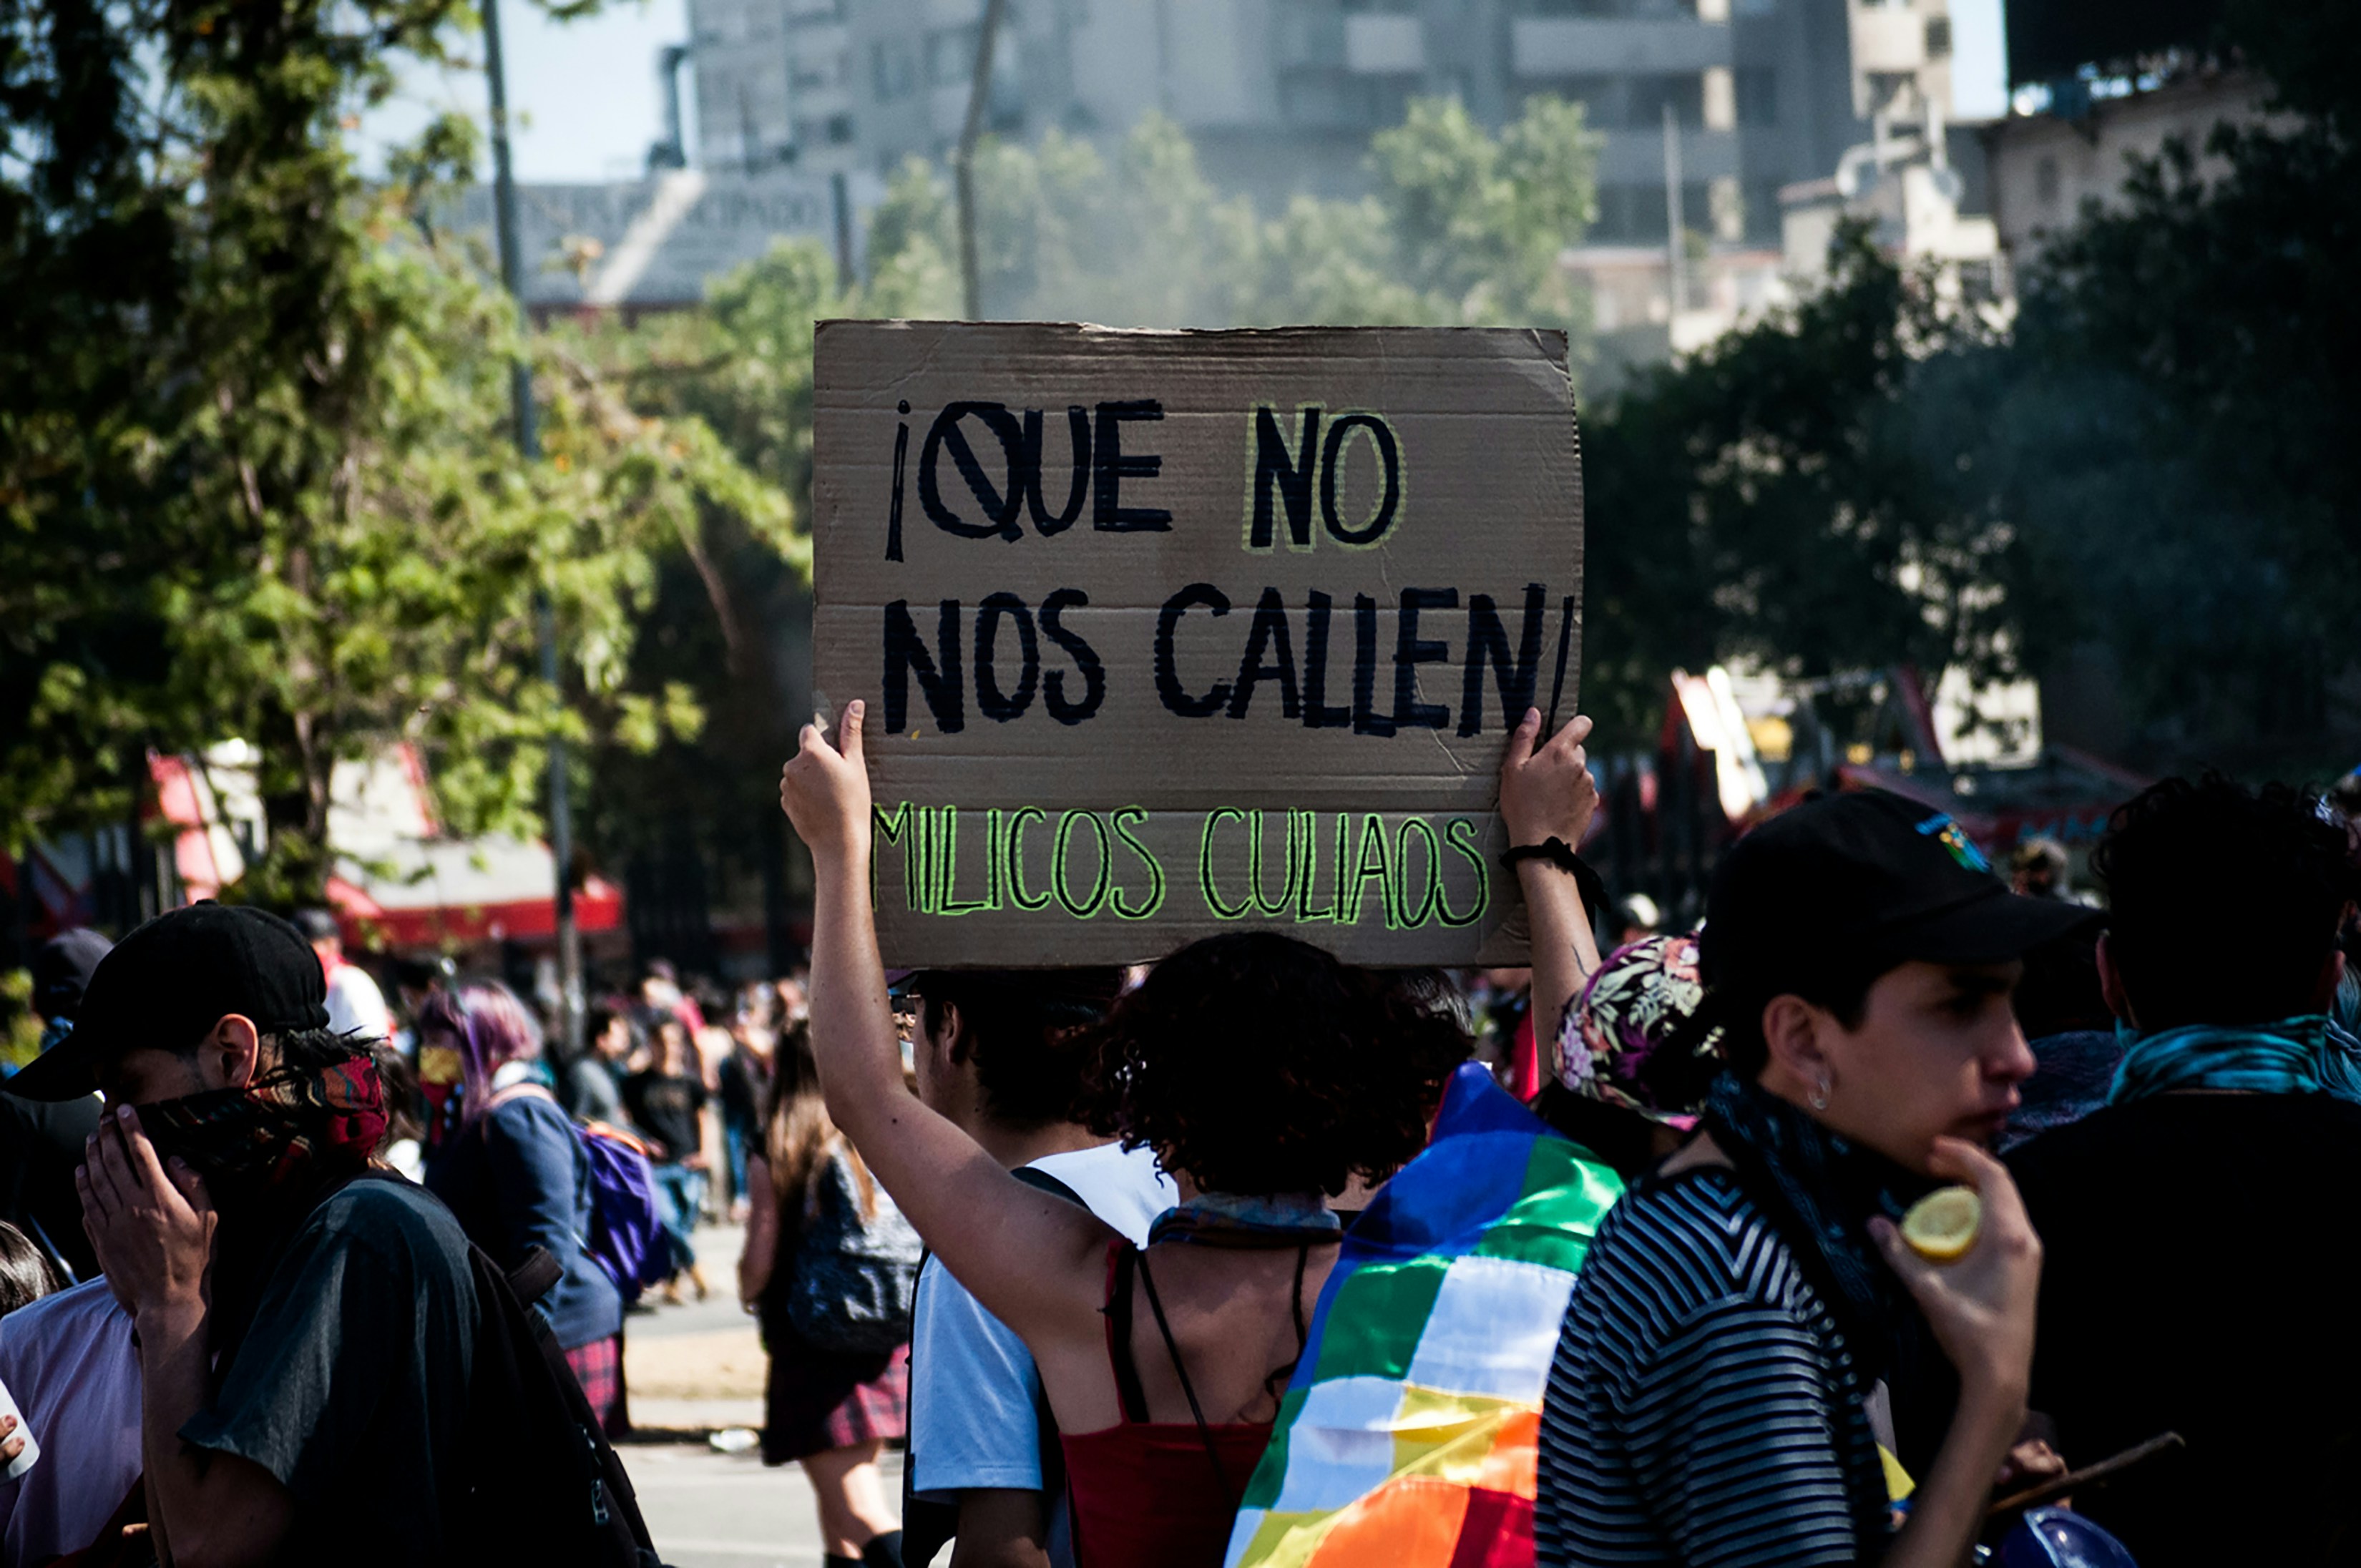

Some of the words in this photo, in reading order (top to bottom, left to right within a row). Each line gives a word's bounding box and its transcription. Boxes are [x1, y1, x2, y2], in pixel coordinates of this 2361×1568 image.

[885, 399, 1173, 563] ¡QUE
[1241, 400, 1408, 554] NO
[882, 587, 1107, 735] NOS
[869, 800, 1166, 920] MILICOS
[1199, 806, 1490, 929] CULIAOS
